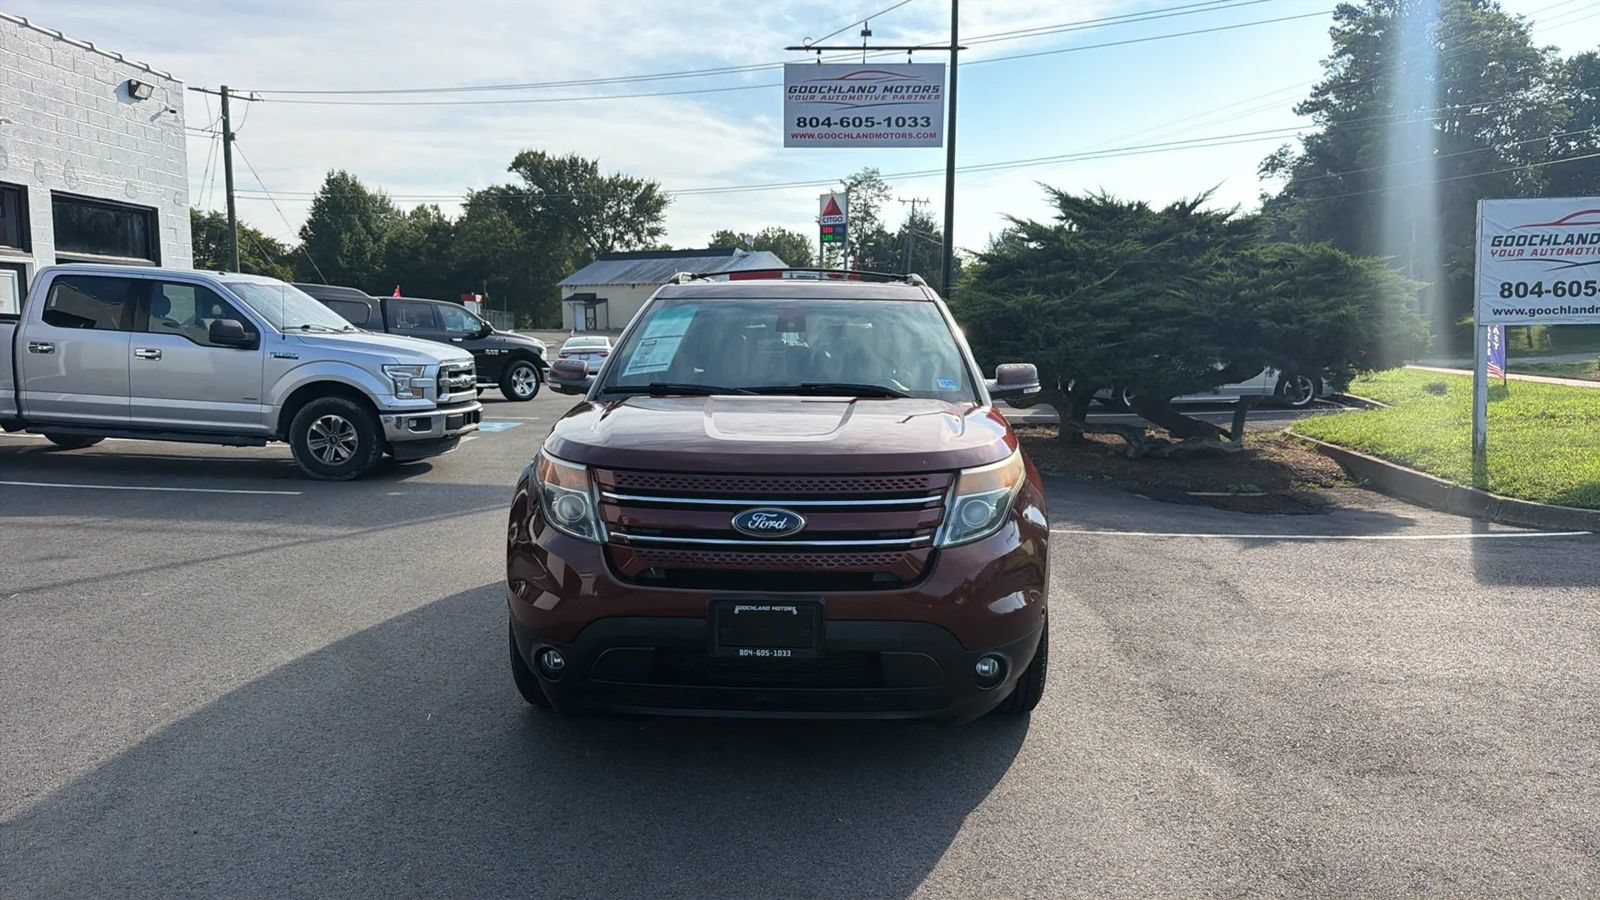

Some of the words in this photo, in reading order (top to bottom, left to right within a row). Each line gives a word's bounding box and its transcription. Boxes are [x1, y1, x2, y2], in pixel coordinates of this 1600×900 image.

[788, 85, 877, 94] GOOCHLAND
[882, 85, 941, 94] MOTORS
[796, 116, 932, 128] 804-605-1033
[790, 132, 937, 140] WWW.GOOCHLANDMOTORS.COM
[1490, 233, 1600, 247] GOOCHLAND
[1490, 249, 1525, 257] YOUR
[1530, 247, 1600, 257] AUTOMOTI
[1499, 280, 1600, 299] 804-605
[747, 512, 788, 530] Ford
[739, 649, 792, 657] 804-605-1033
